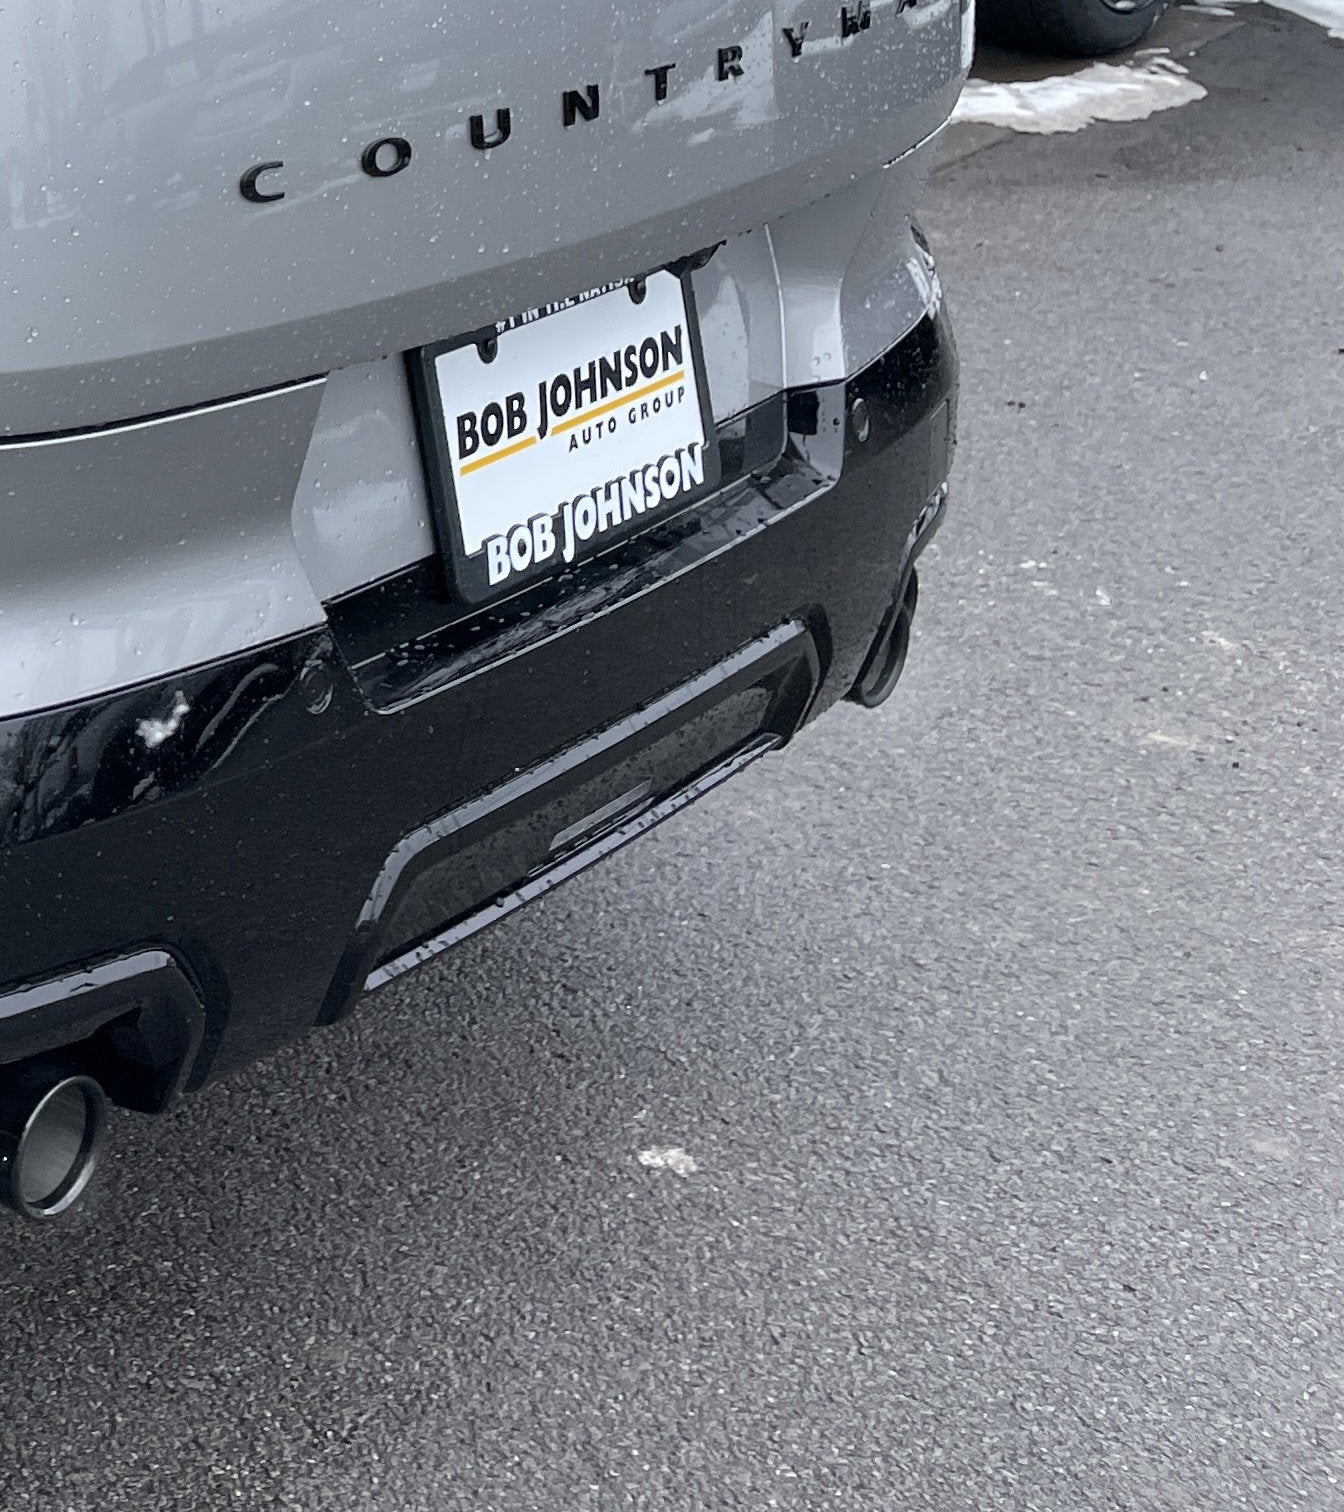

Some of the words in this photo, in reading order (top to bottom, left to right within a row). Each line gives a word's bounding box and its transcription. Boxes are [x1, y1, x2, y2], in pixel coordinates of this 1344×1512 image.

[456, 392, 527, 460] BOB
[537, 325, 684, 440] JOHNSON
[568, 415, 617, 453] AUTO
[628, 386, 686, 423] GROUP
[485, 515, 556, 586] BOB
[561, 445, 706, 564] JOHNSON
